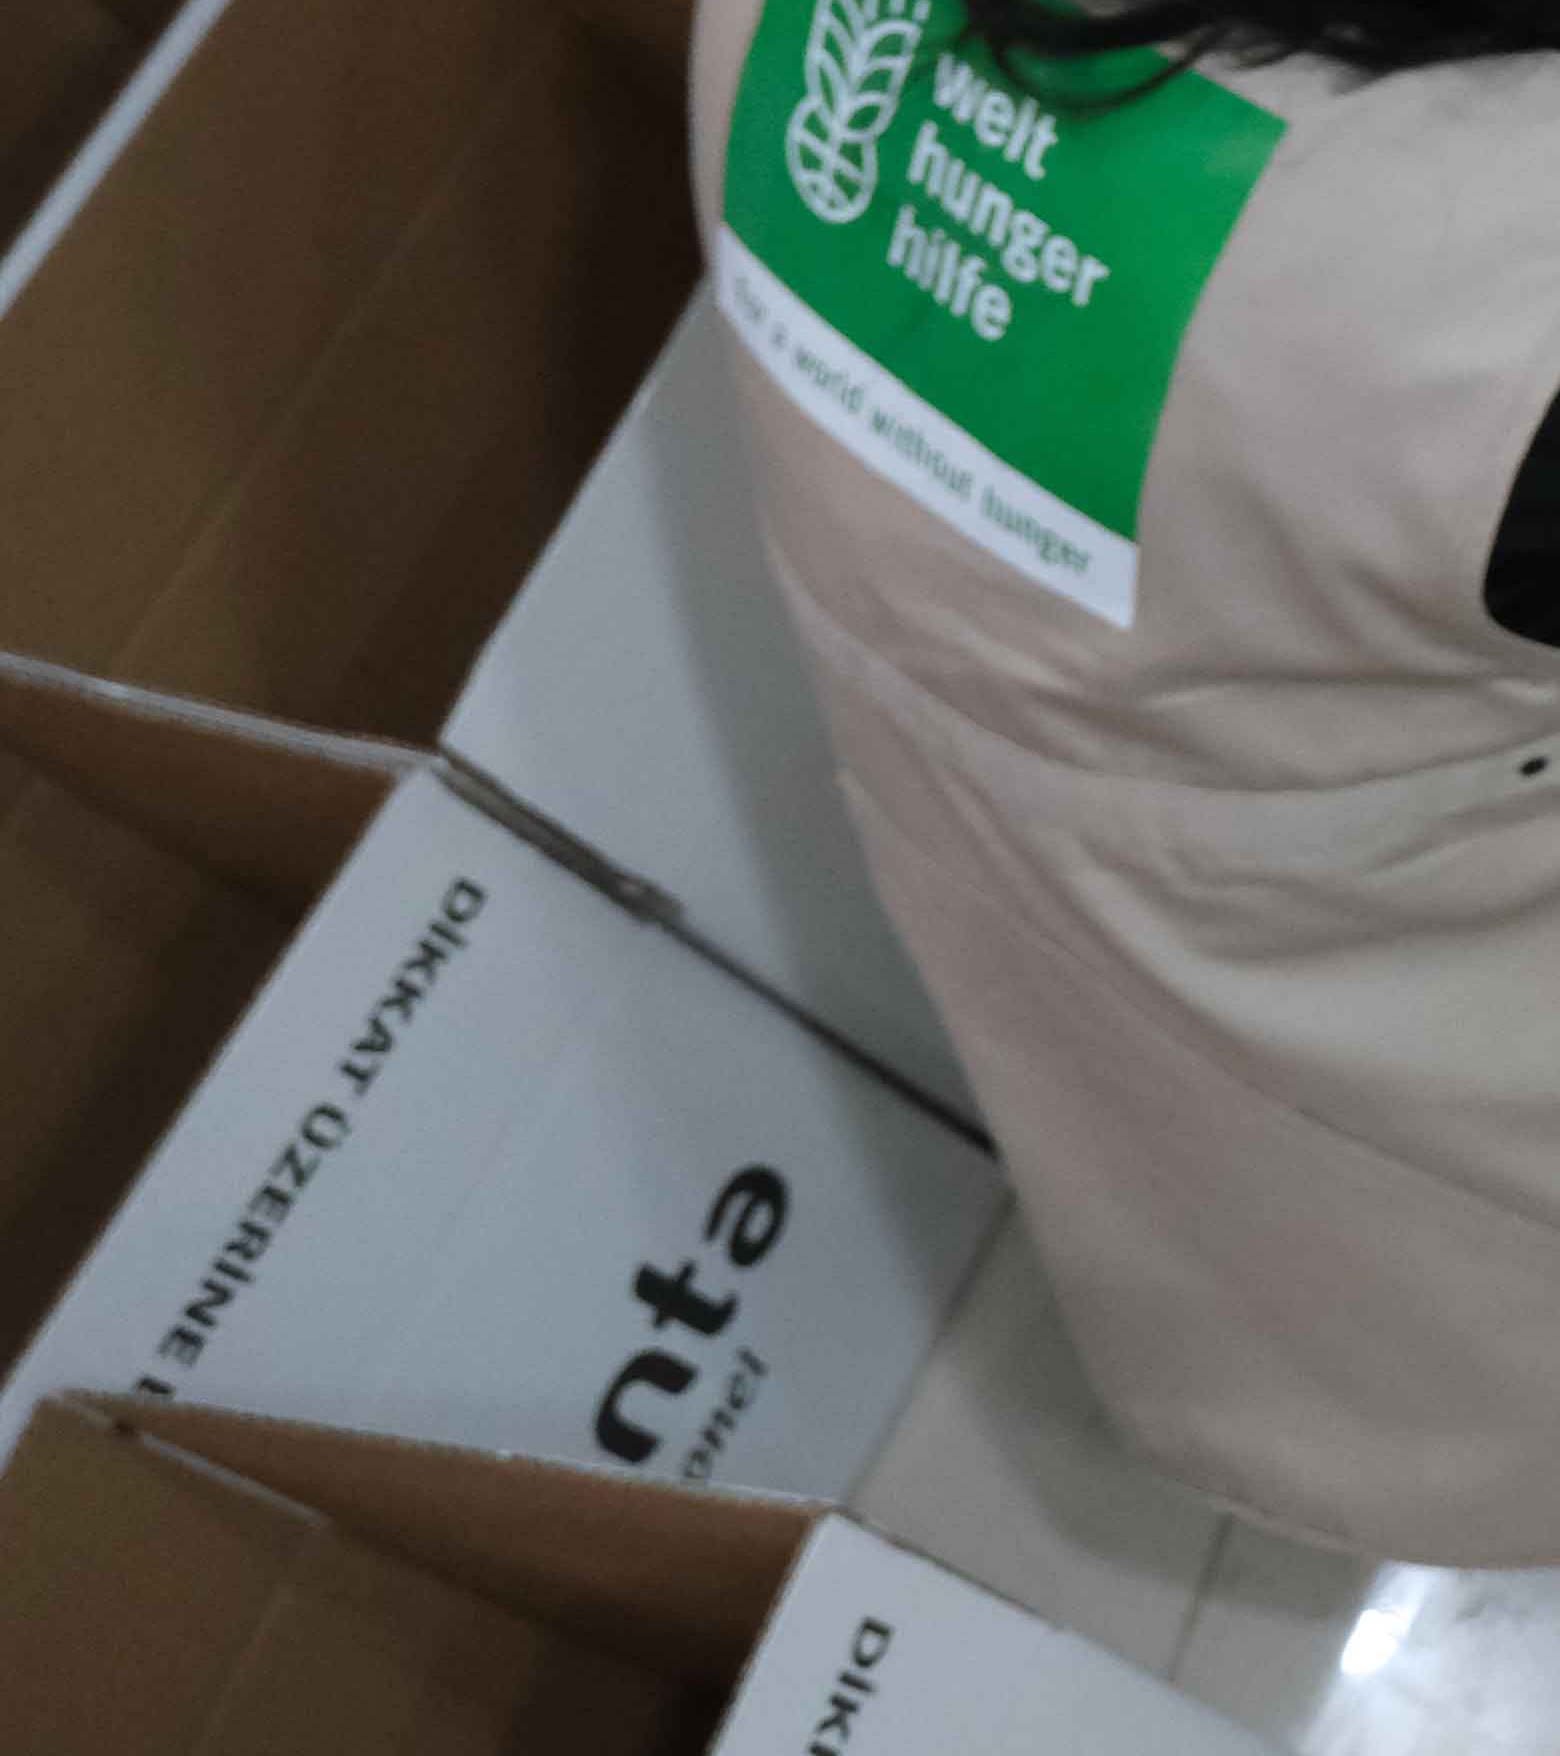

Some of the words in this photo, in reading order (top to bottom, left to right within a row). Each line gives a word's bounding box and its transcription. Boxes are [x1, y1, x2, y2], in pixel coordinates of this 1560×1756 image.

[932, 50, 1060, 182] welt
[885, 203, 1012, 342] hilfe
[907, 117, 1111, 309] hunger
[870, 401, 976, 502] without
[980, 482, 1091, 579] hunger
[338, 875, 491, 1097] DİKKAT
[157, 1100, 354, 1372] ÜZERİNE
